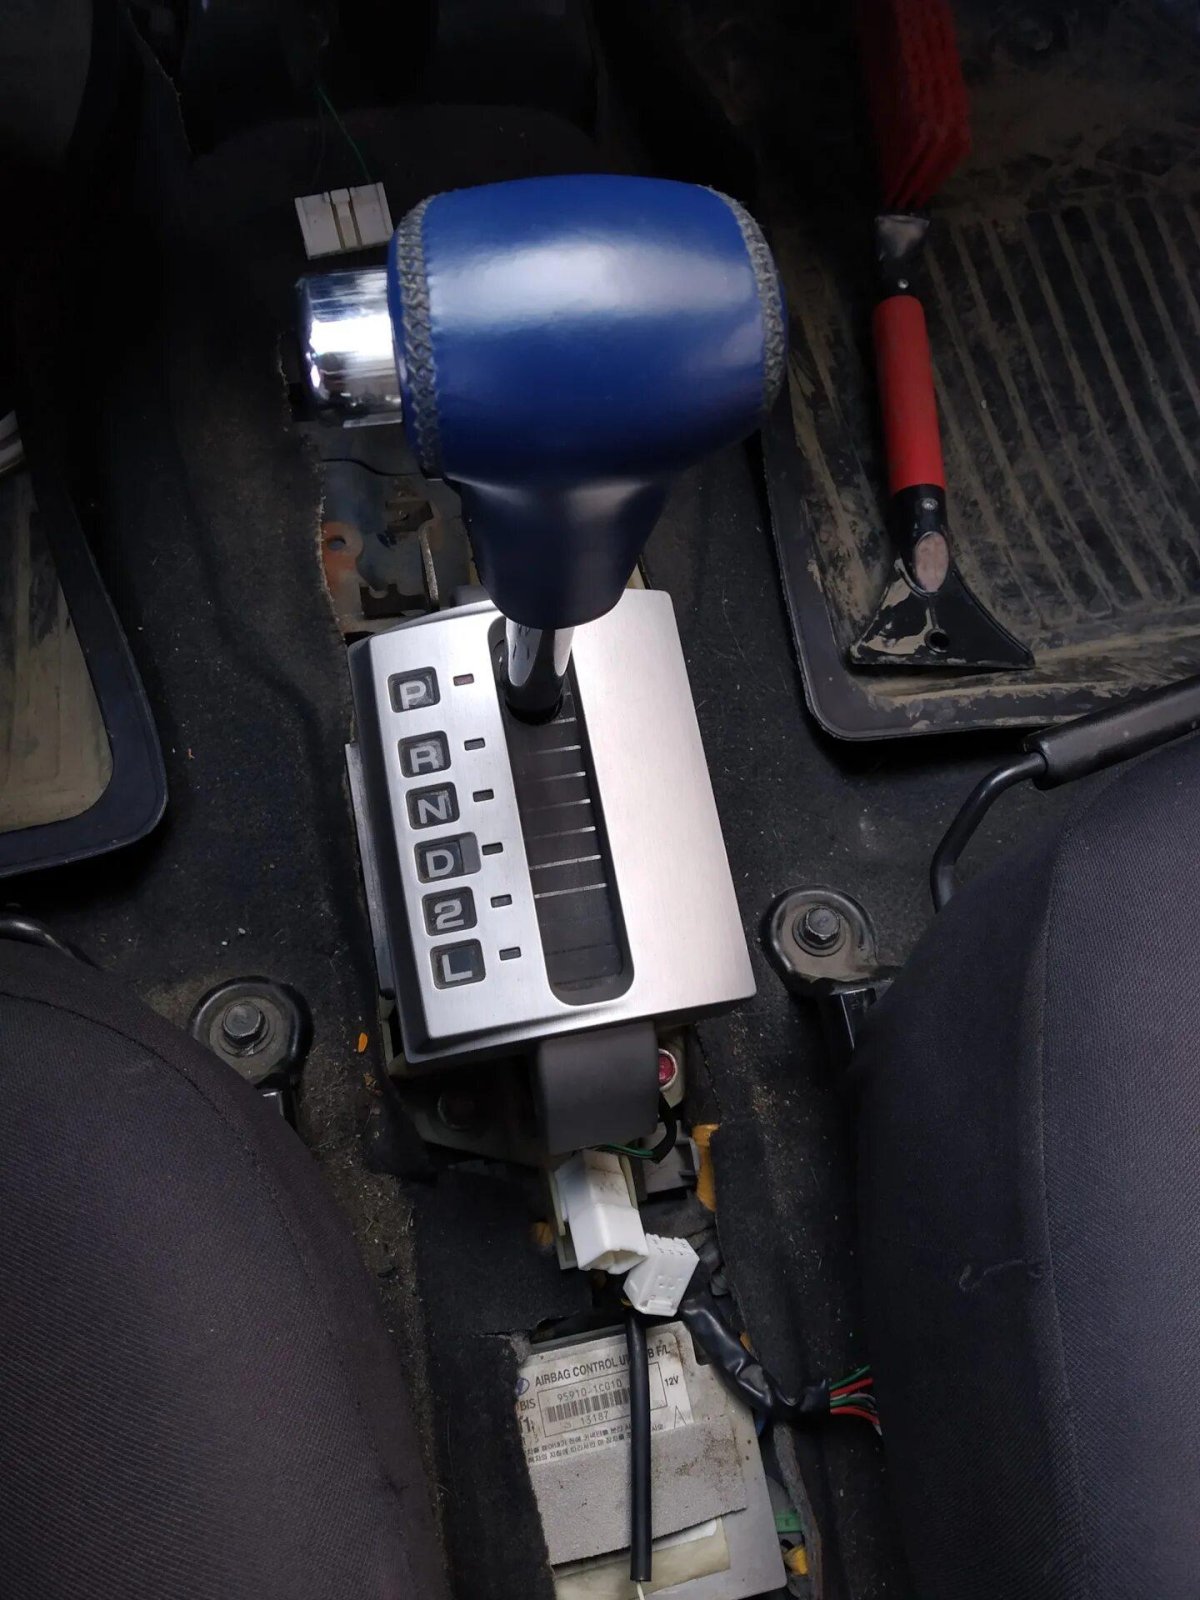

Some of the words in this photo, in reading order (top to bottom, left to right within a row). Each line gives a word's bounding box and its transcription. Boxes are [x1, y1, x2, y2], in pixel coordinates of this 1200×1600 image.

[399, 680, 427, 710] P
[409, 747, 440, 774] R
[417, 799, 448, 825] N
[425, 850, 455, 878] D
[434, 899, 465, 930] 2
[441, 954, 473, 983] L
[535, 1369, 571, 1387] AIRBAG
[572, 1358, 619, 1377] CONTROL
[664, 1376, 679, 1387] 12V
